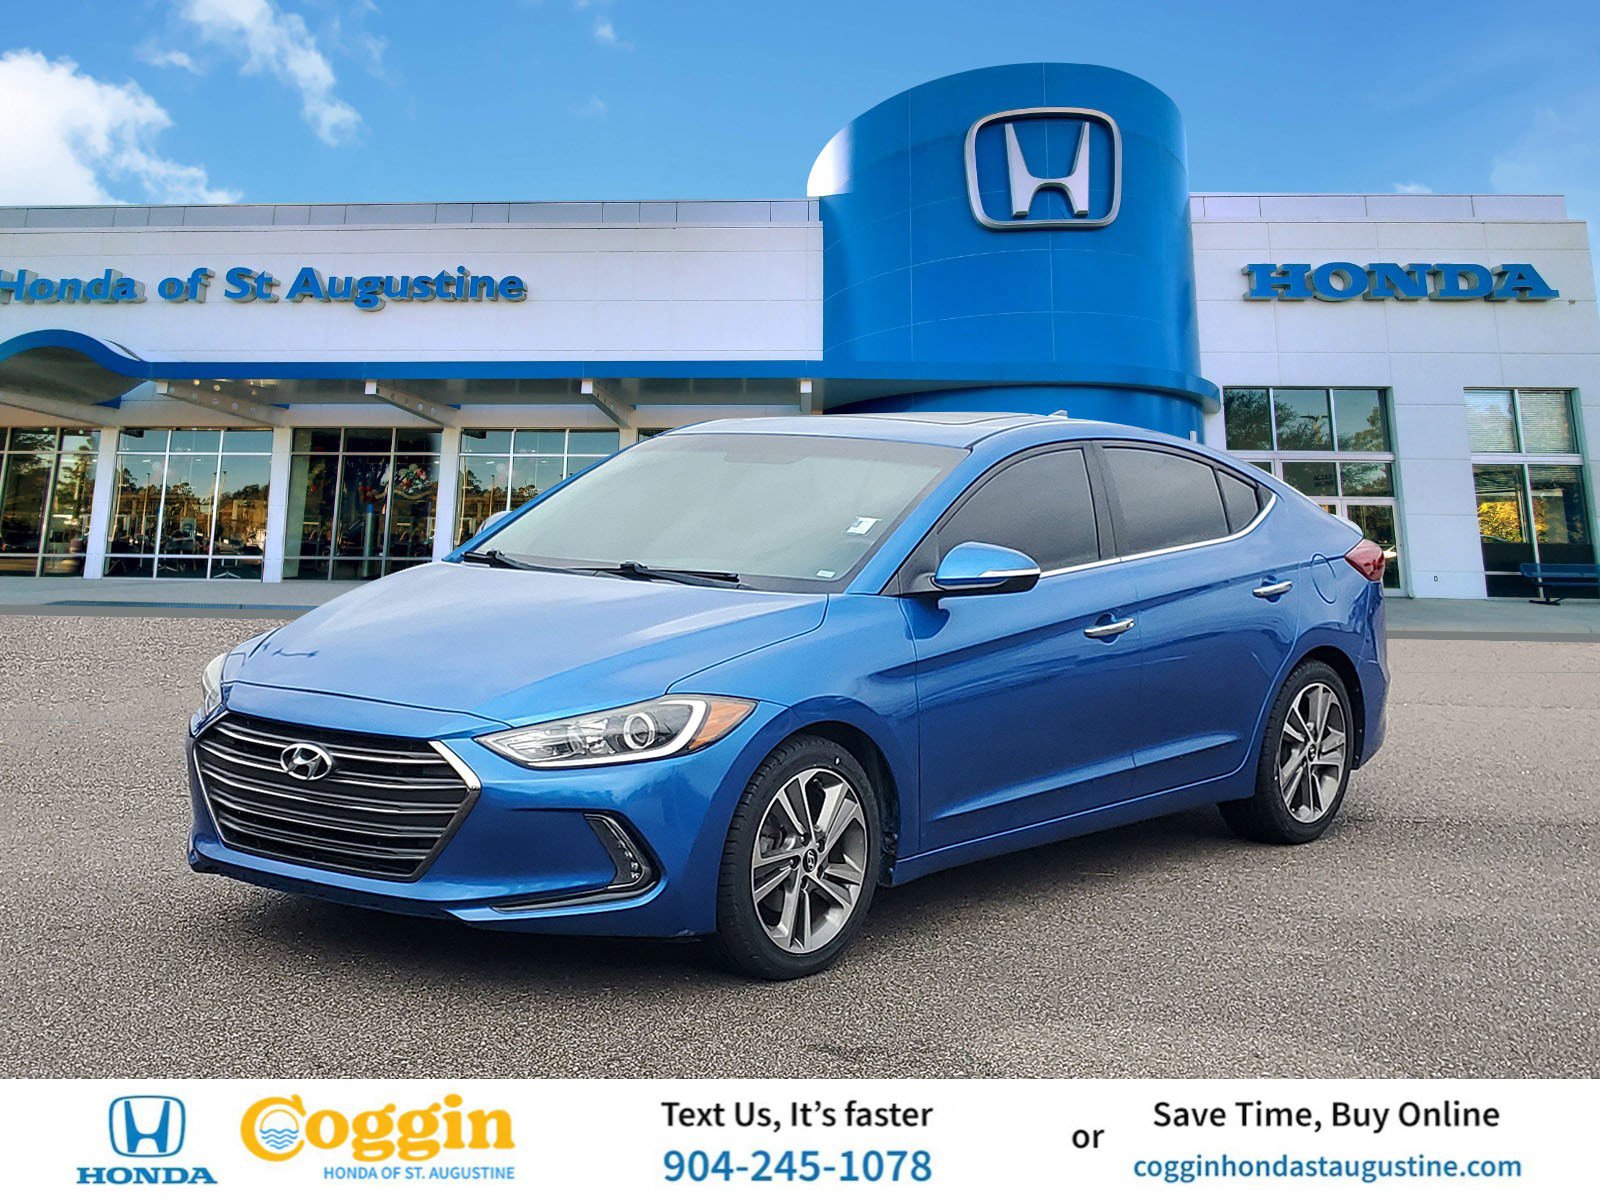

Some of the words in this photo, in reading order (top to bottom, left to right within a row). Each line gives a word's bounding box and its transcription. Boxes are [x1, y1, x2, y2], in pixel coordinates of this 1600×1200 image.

[0, 268, 141, 303] Honda
[157, 268, 213, 302] of
[224, 267, 279, 301] St
[286, 265, 527, 309] Augustine
[1243, 262, 1560, 301] HONDA
